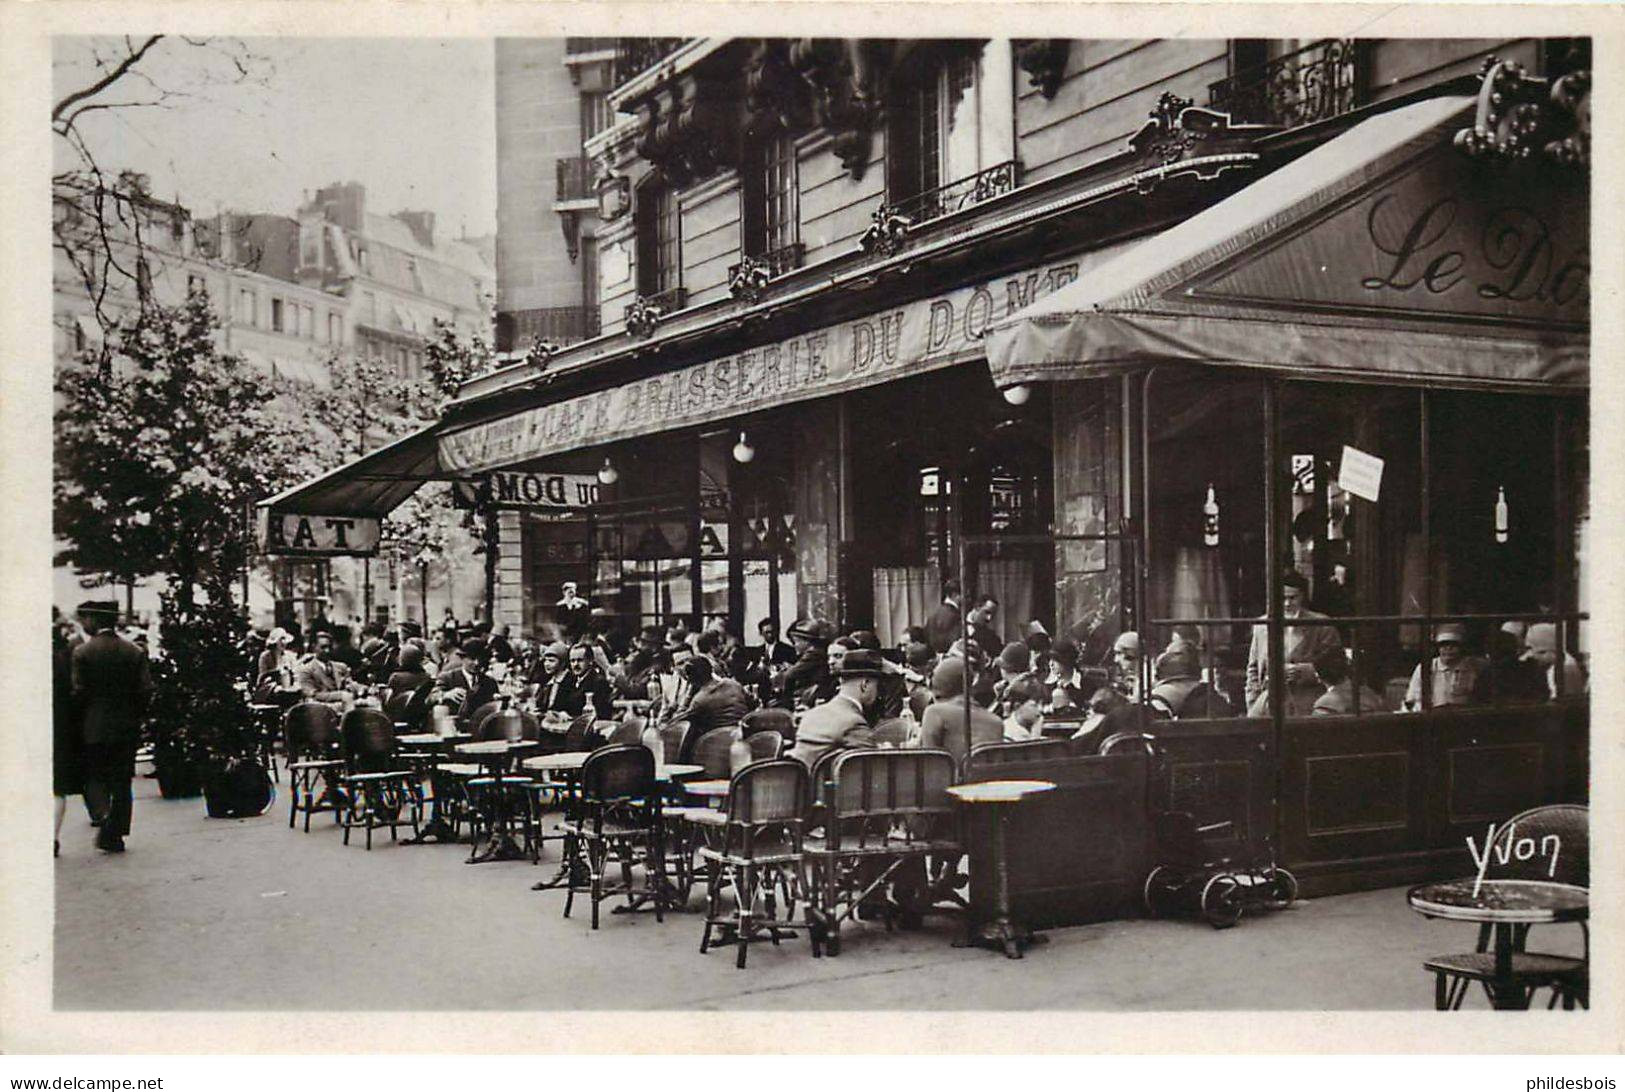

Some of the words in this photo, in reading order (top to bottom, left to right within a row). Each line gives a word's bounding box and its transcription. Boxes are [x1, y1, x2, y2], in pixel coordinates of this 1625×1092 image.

[1361, 193, 1465, 293] Le
[625, 333, 828, 422] BRASSERIE
[852, 311, 904, 373] DU
